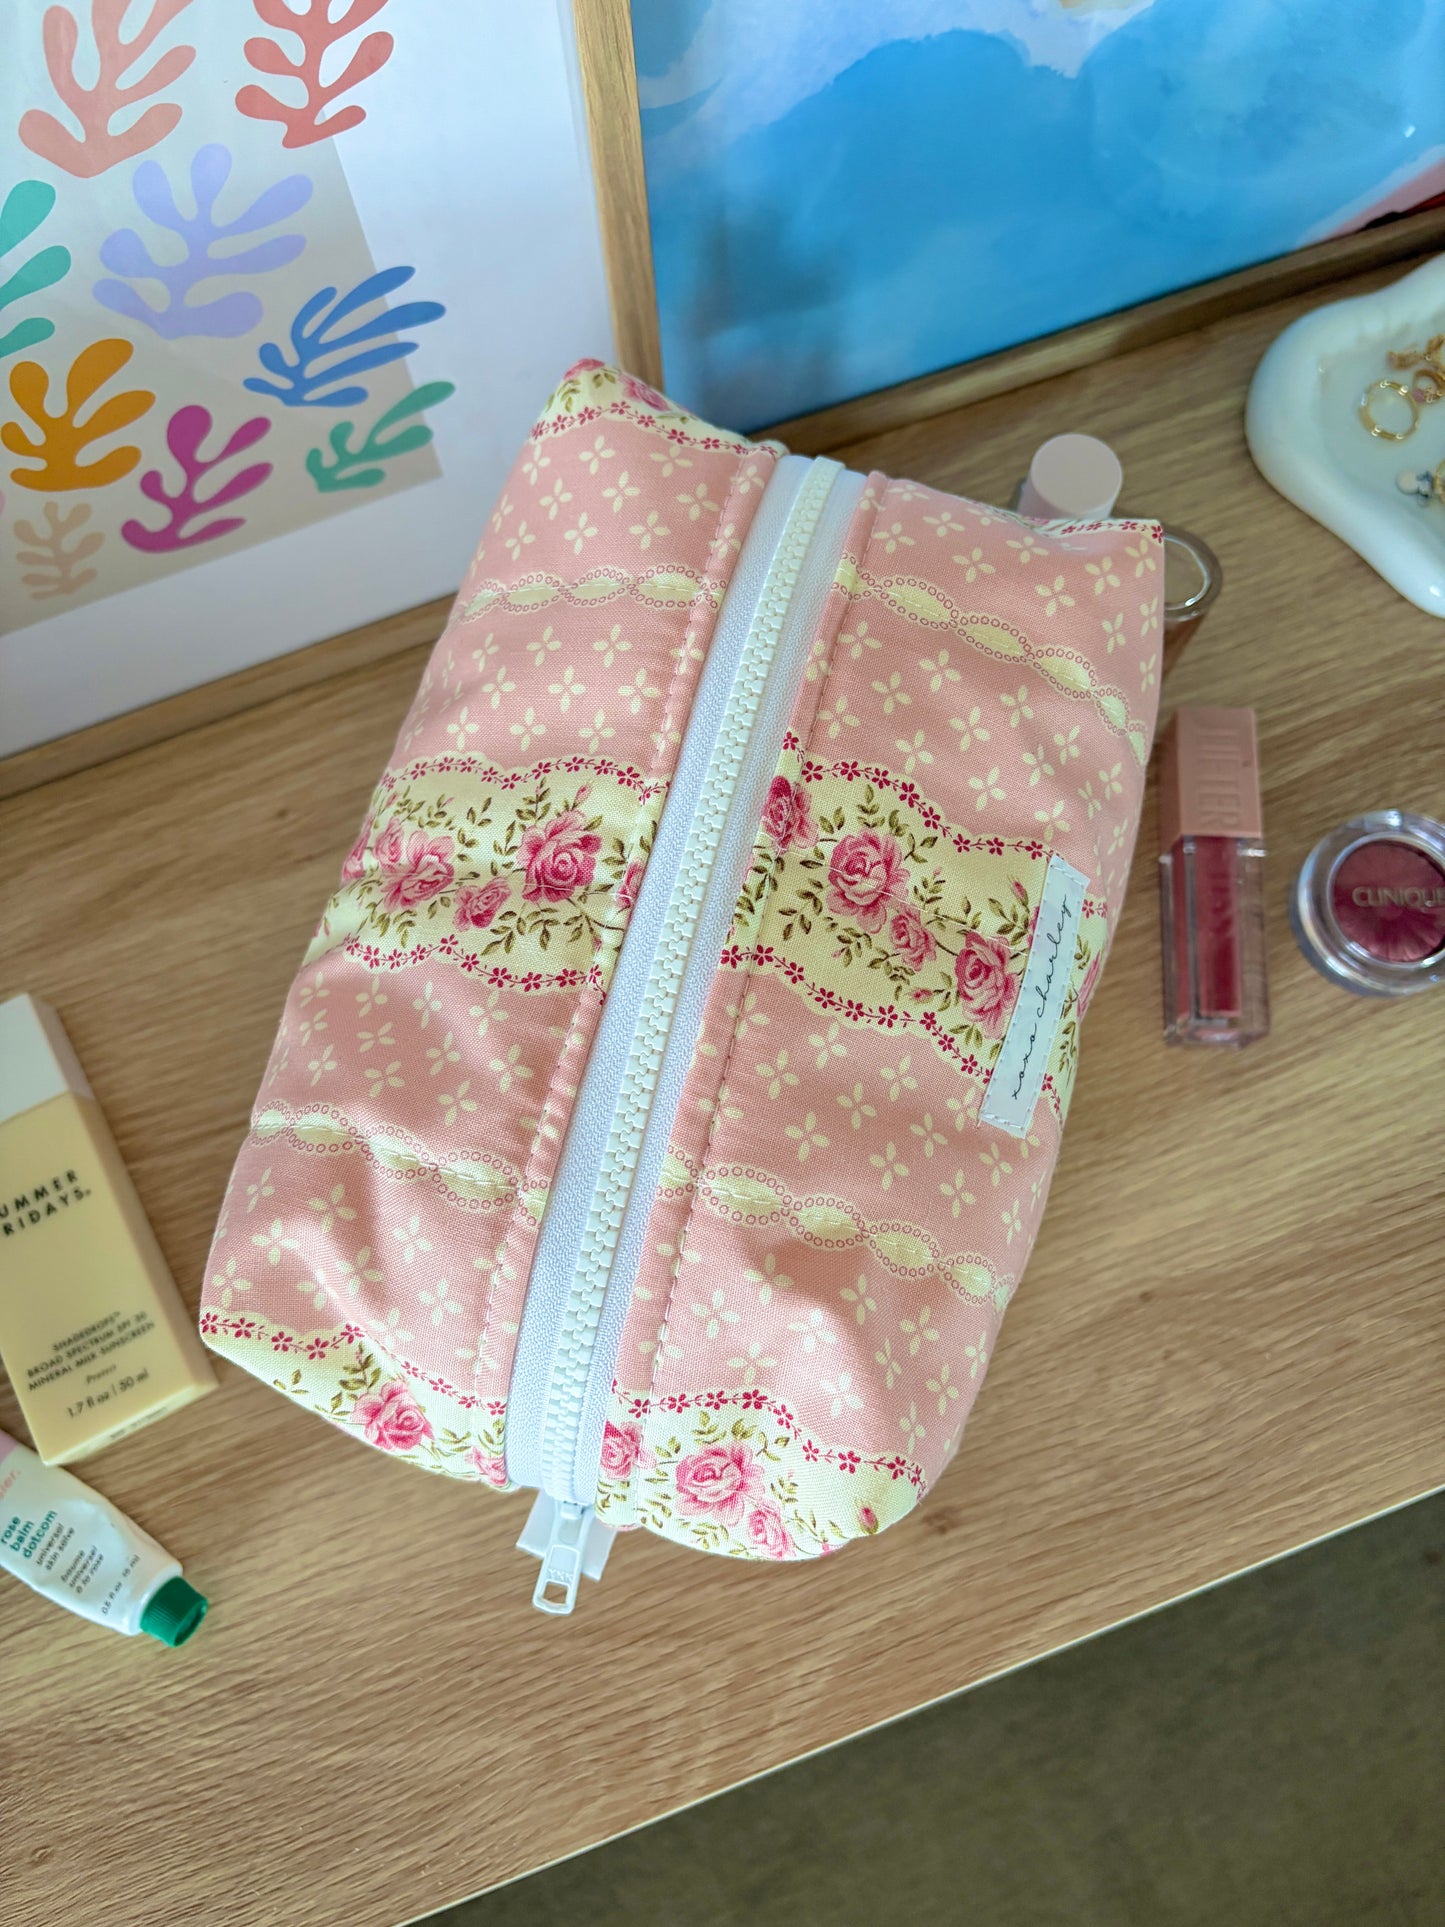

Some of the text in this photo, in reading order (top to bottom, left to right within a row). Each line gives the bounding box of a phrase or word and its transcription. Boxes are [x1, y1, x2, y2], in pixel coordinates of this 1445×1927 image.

[1011, 894, 1072, 1100] xoxo charley
[27, 1354, 64, 1378] BROAD
[0, 1516, 20, 1545] rose
[10, 1520, 34, 1551] balm
[23, 1510, 58, 1559] dotcom
